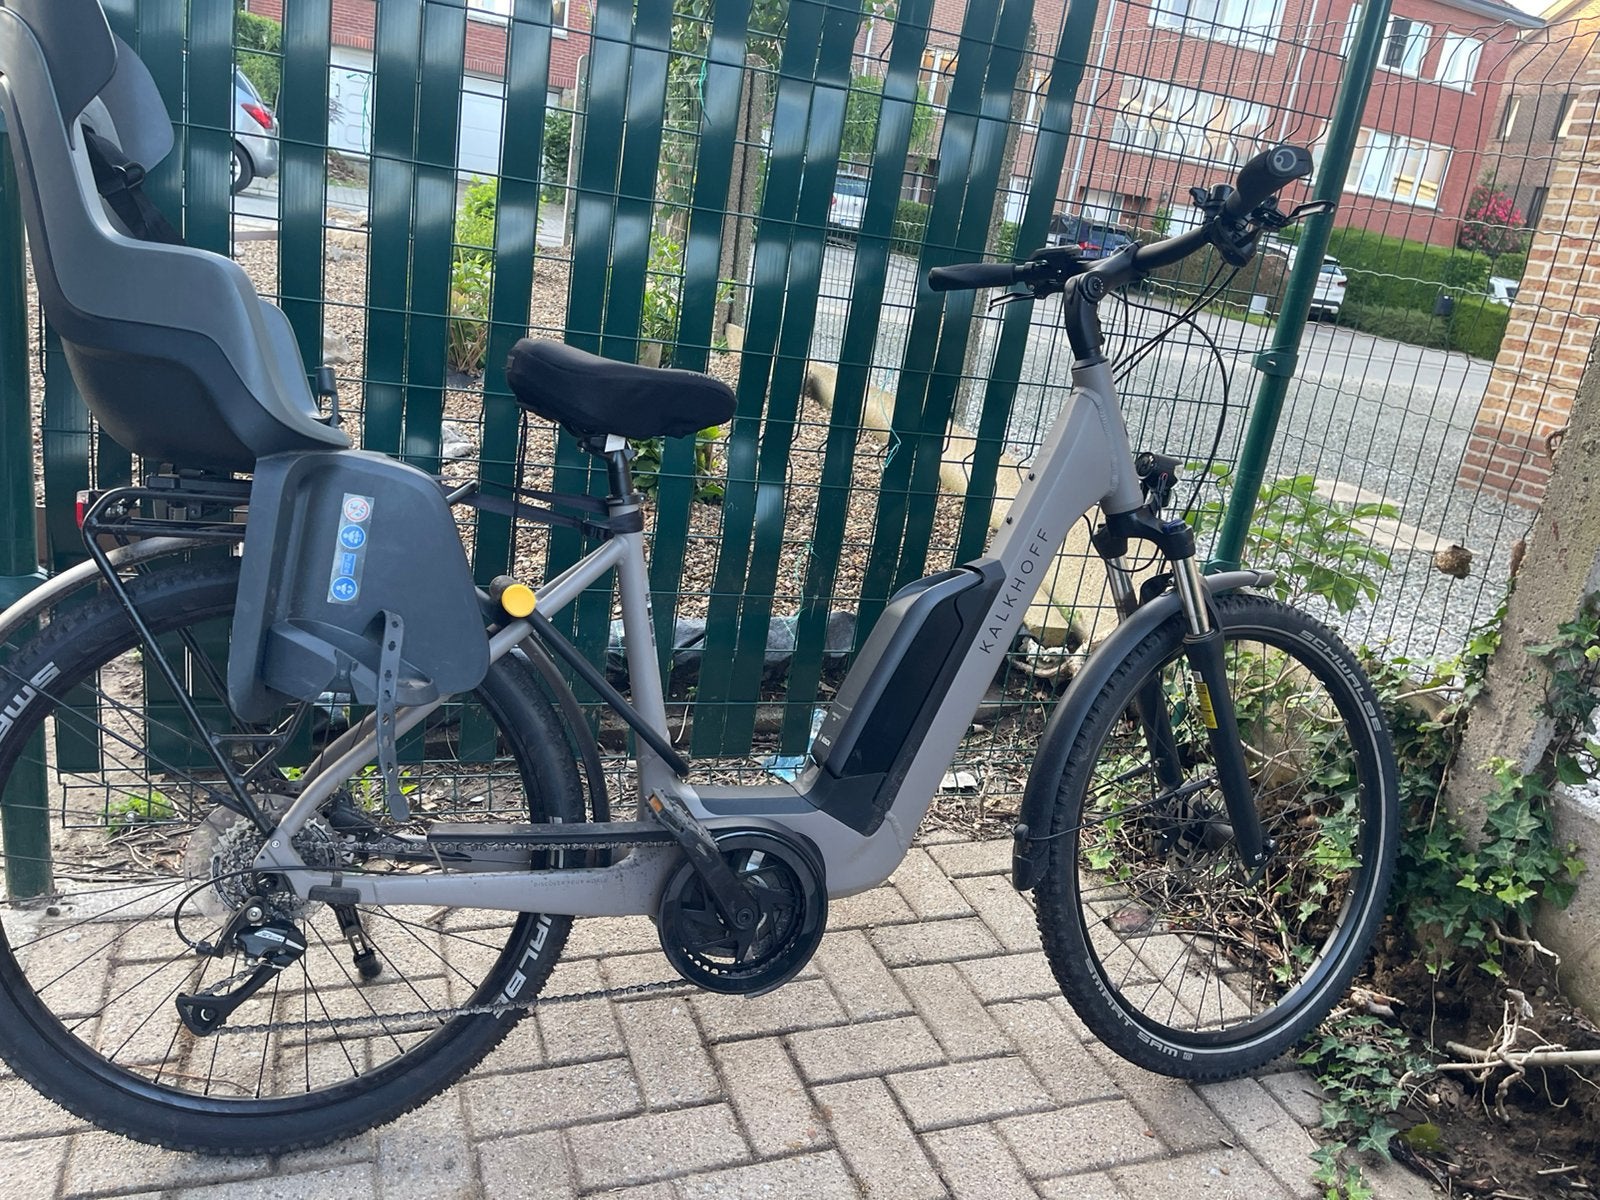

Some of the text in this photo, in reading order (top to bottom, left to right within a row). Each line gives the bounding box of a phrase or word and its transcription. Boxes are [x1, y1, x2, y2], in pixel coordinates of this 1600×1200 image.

[979, 528, 1049, 654] KALKHOFF
[1298, 630, 1382, 732] SCHWALBE
[1136, 1030, 1178, 1058] SAM
